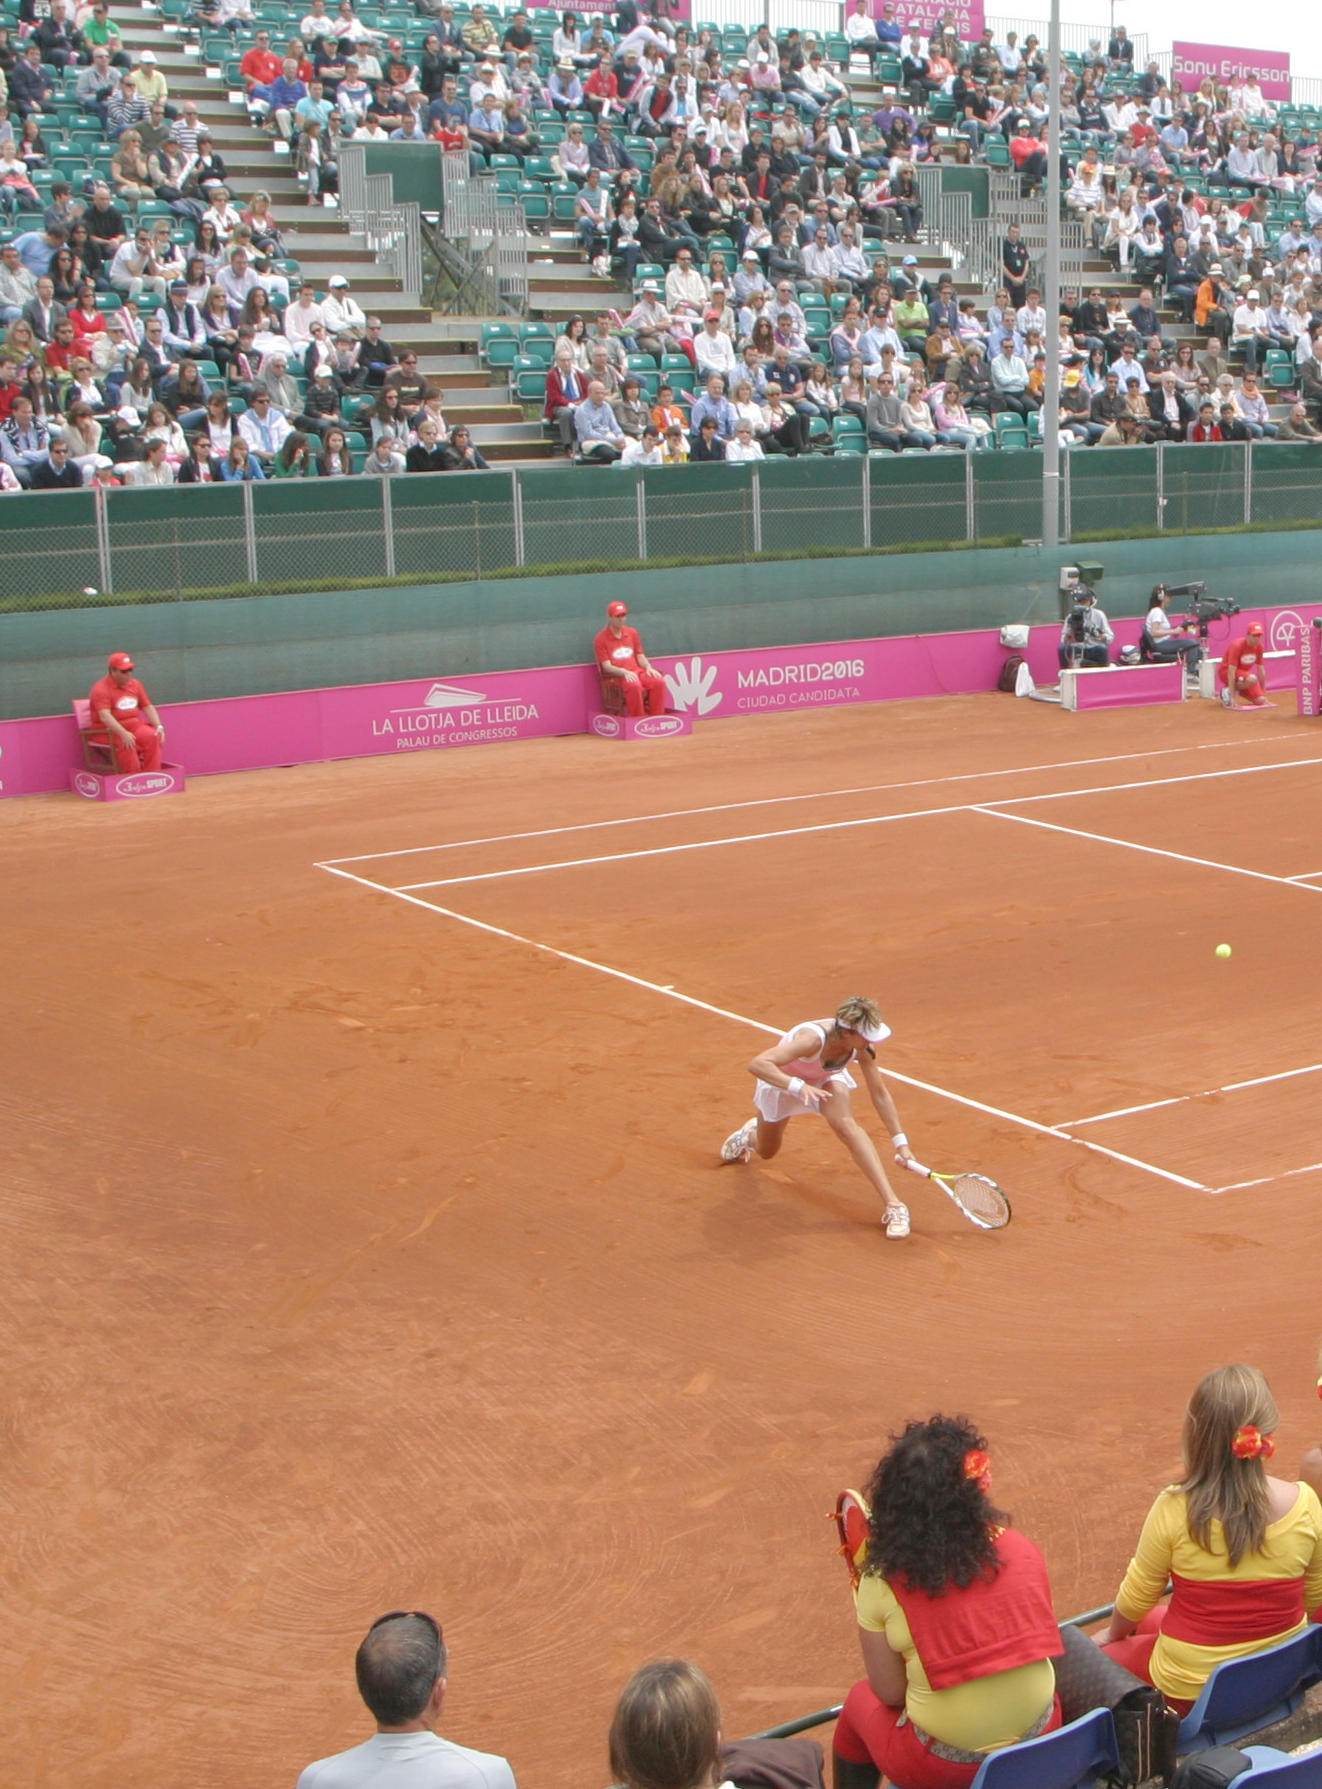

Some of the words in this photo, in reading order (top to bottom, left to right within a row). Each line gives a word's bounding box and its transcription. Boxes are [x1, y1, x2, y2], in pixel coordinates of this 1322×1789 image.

[1173, 55, 1217, 75] Sony
[1221, 60, 1290, 83] Ericsson
[1300, 627, 1312, 684] PARIBAS
[737, 659, 865, 689] MADRID2016
[737, 693, 786, 709] CIUDAD
[789, 687, 861, 704] CANDIDATA
[1303, 687, 1313, 715] BNP
[372, 718, 394, 736] LA
[399, 712, 456, 733] LLOTJA
[460, 709, 482, 726] DE
[487, 704, 539, 724] LLEIDA
[397, 735, 430, 749] PALAU
[433, 734, 446, 745] DE
[449, 726, 518, 743] CONGRESSOS
